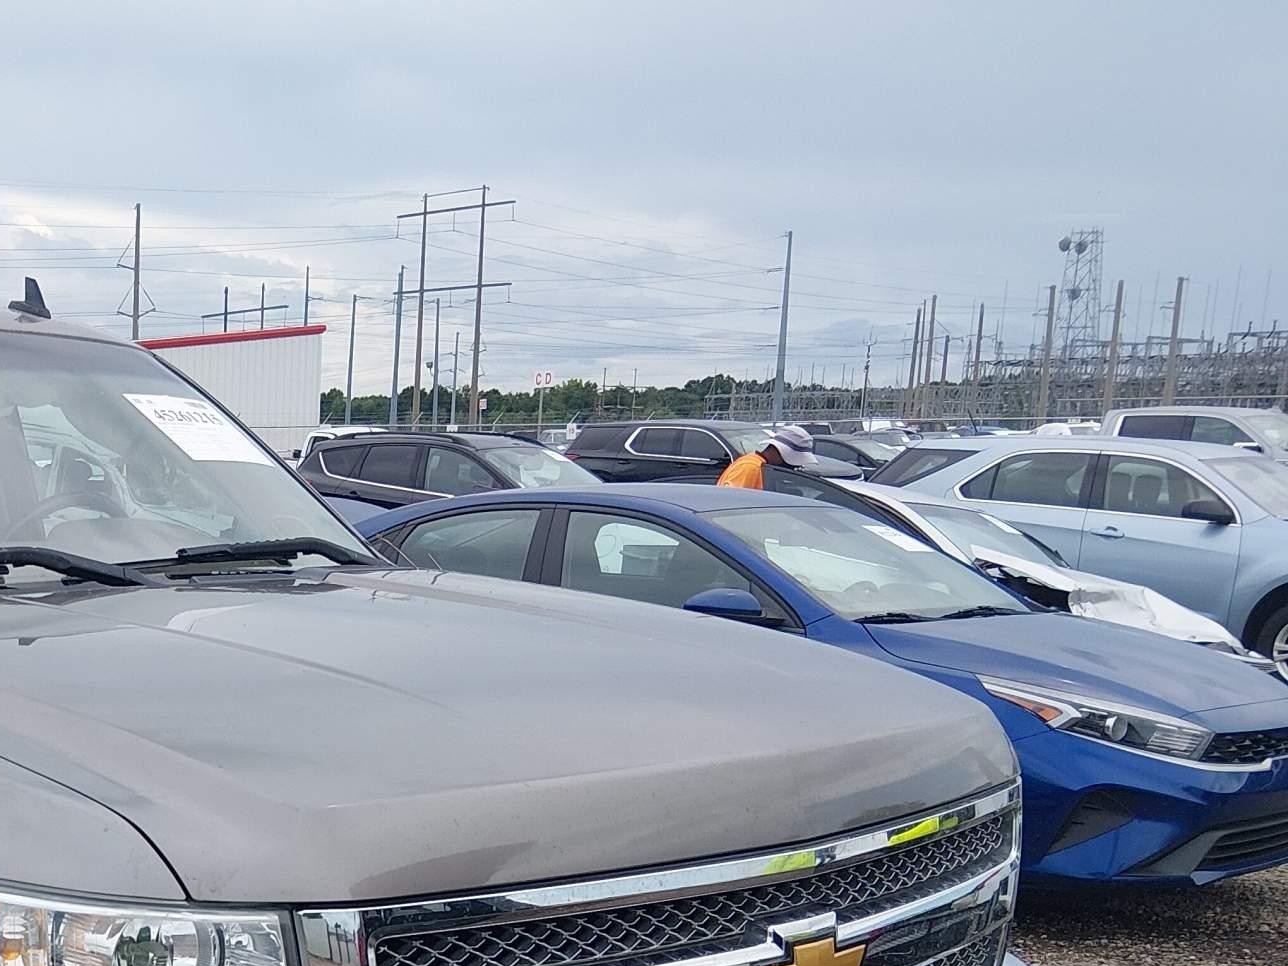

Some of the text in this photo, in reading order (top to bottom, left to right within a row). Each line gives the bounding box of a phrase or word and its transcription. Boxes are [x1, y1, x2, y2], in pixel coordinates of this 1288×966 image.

[535, 372, 552, 386] C D
[153, 408, 224, 426] 45261215
